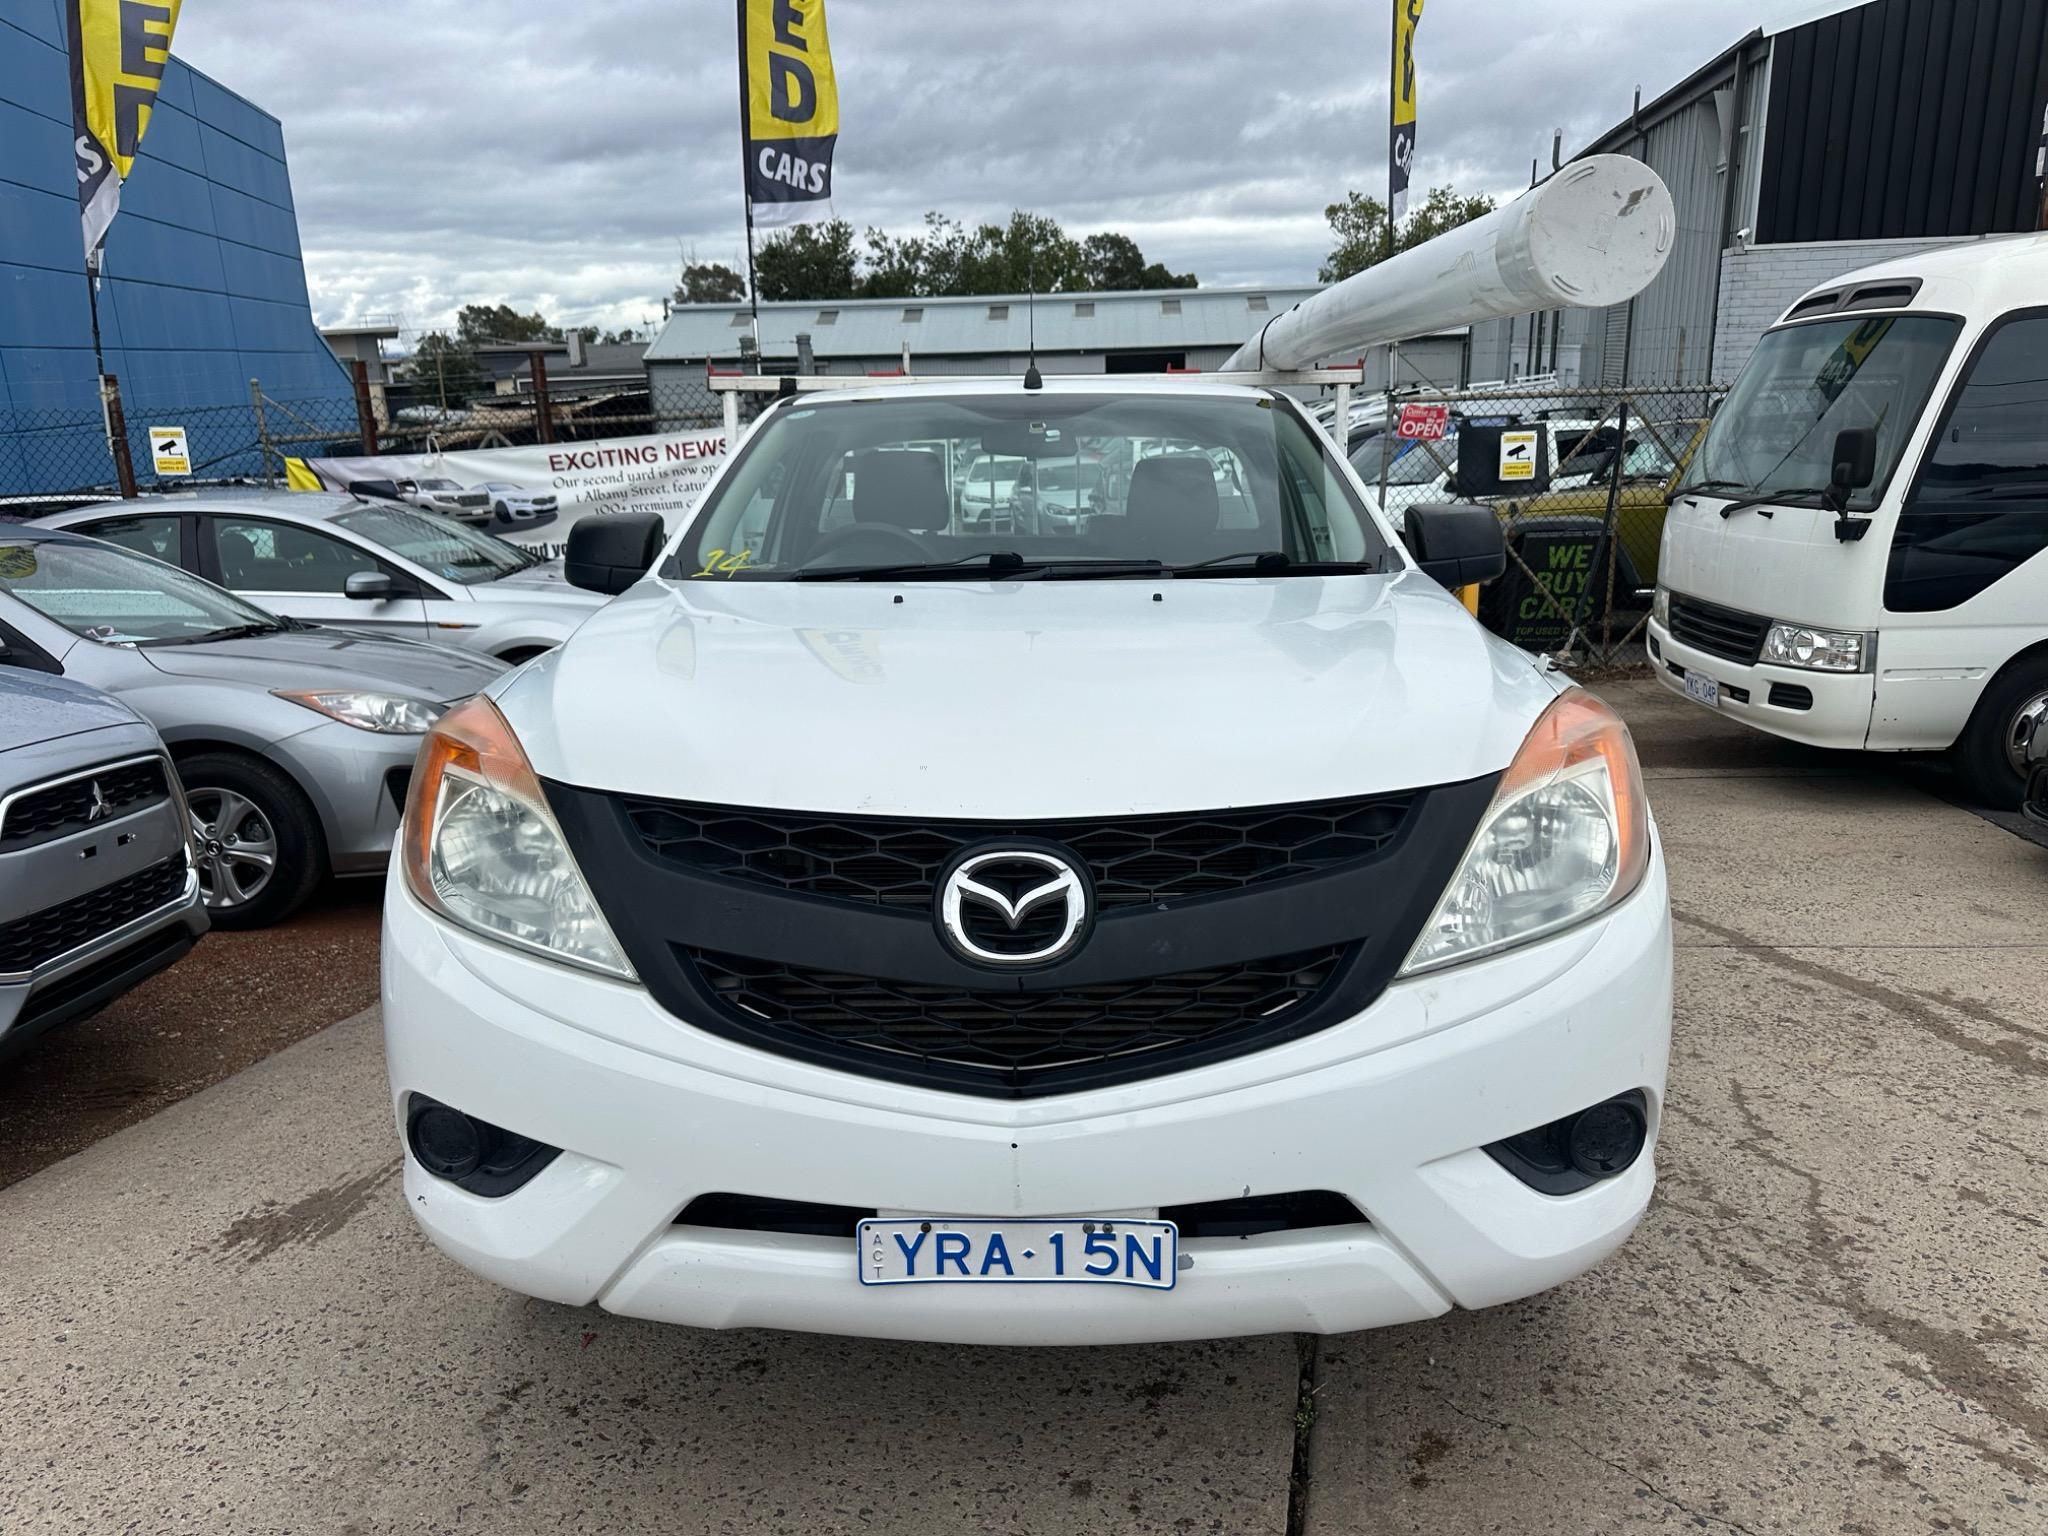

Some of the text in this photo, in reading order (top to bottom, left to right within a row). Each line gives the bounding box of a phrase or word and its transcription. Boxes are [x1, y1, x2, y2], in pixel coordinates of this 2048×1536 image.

[758, 147, 826, 194] CARS
[1402, 420, 1445, 438] OPEN
[549, 446, 658, 472] EXCITING
[553, 464, 719, 489] Our second yard is now op
[584, 488, 628, 503] Albany
[630, 485, 670, 497] Street,
[673, 477, 710, 493] featur
[595, 503, 626, 515] 100+
[631, 497, 683, 513] premium
[691, 548, 753, 579] 14
[1548, 545, 1594, 568] WE
[1534, 571, 1591, 593] BUY
[872, 1232, 883, 1278] ACT
